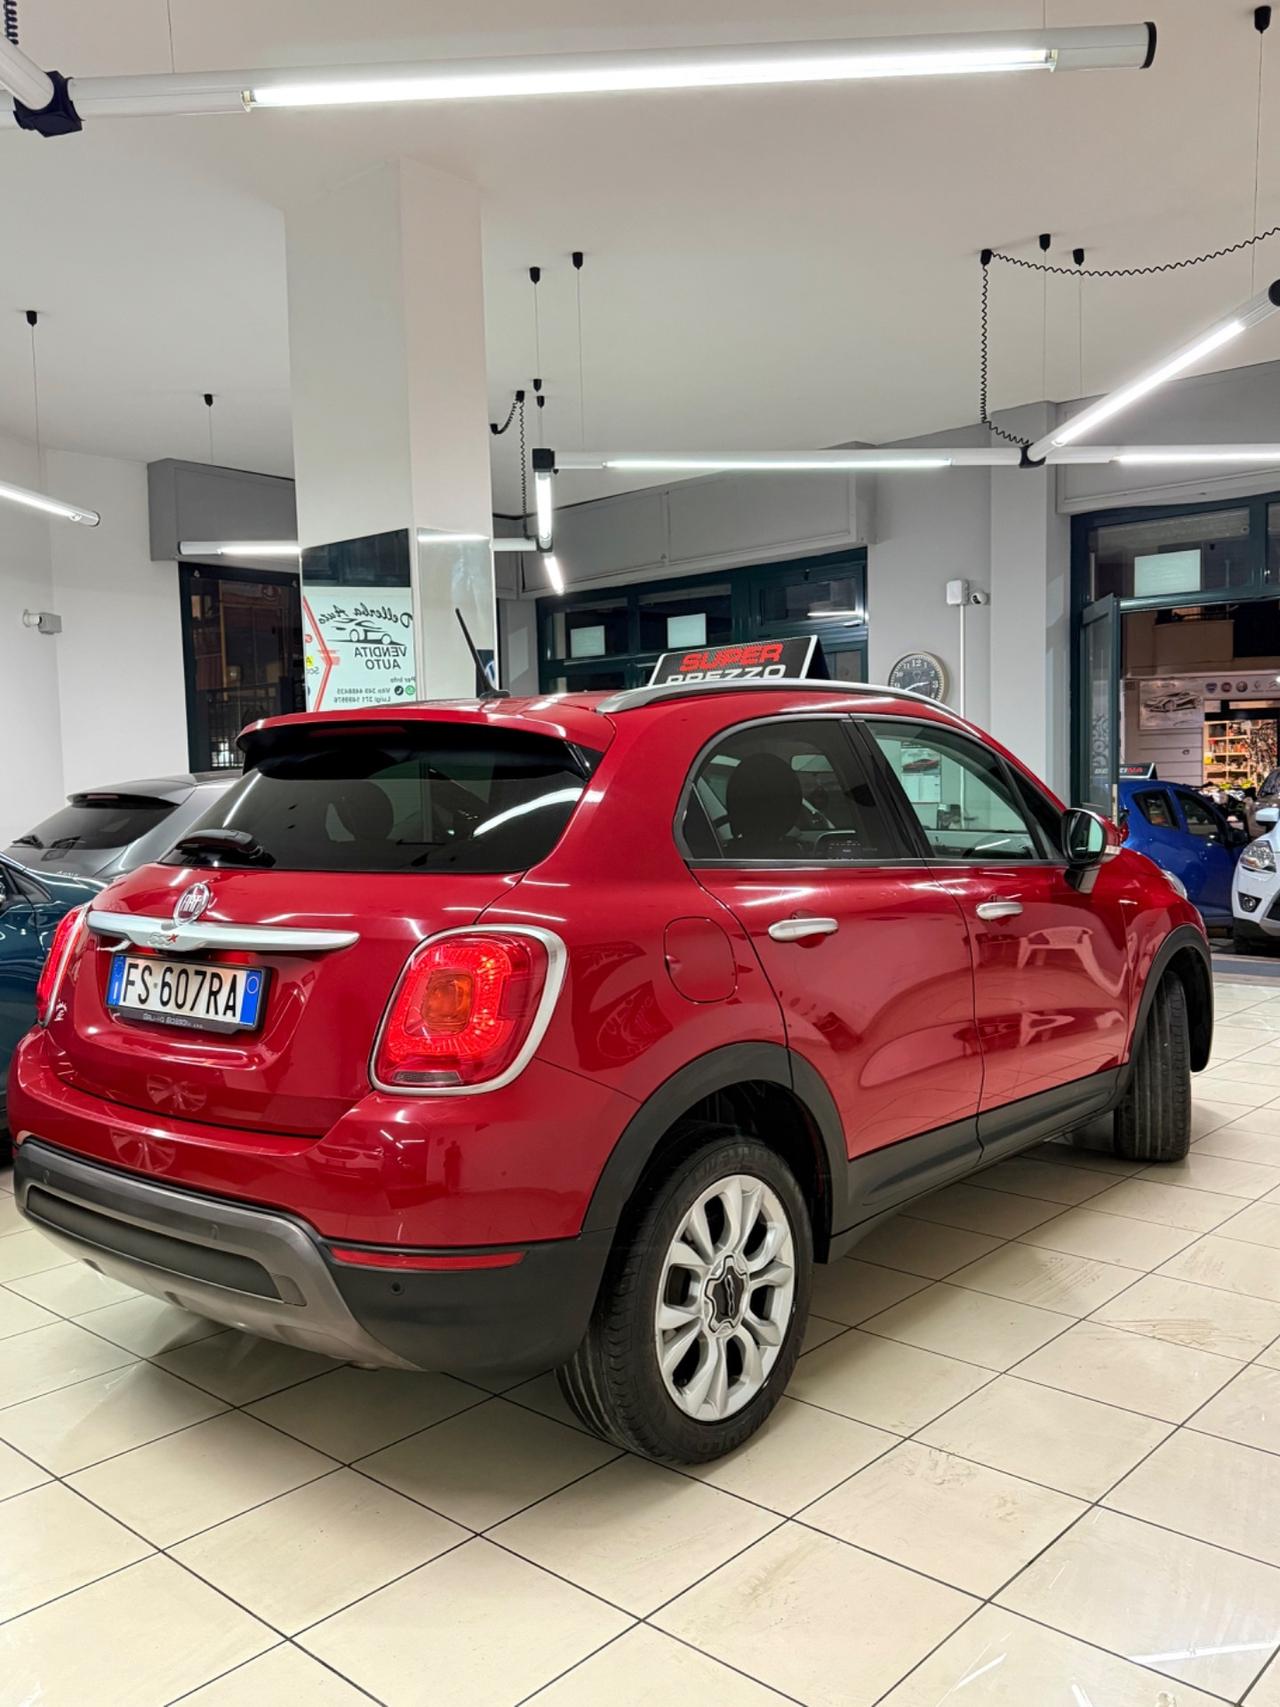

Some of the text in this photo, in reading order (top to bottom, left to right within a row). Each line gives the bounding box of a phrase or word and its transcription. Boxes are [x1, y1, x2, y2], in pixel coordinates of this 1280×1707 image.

[679, 642, 784, 672] SUPER
[122, 963, 238, 1018] FS 607RA
